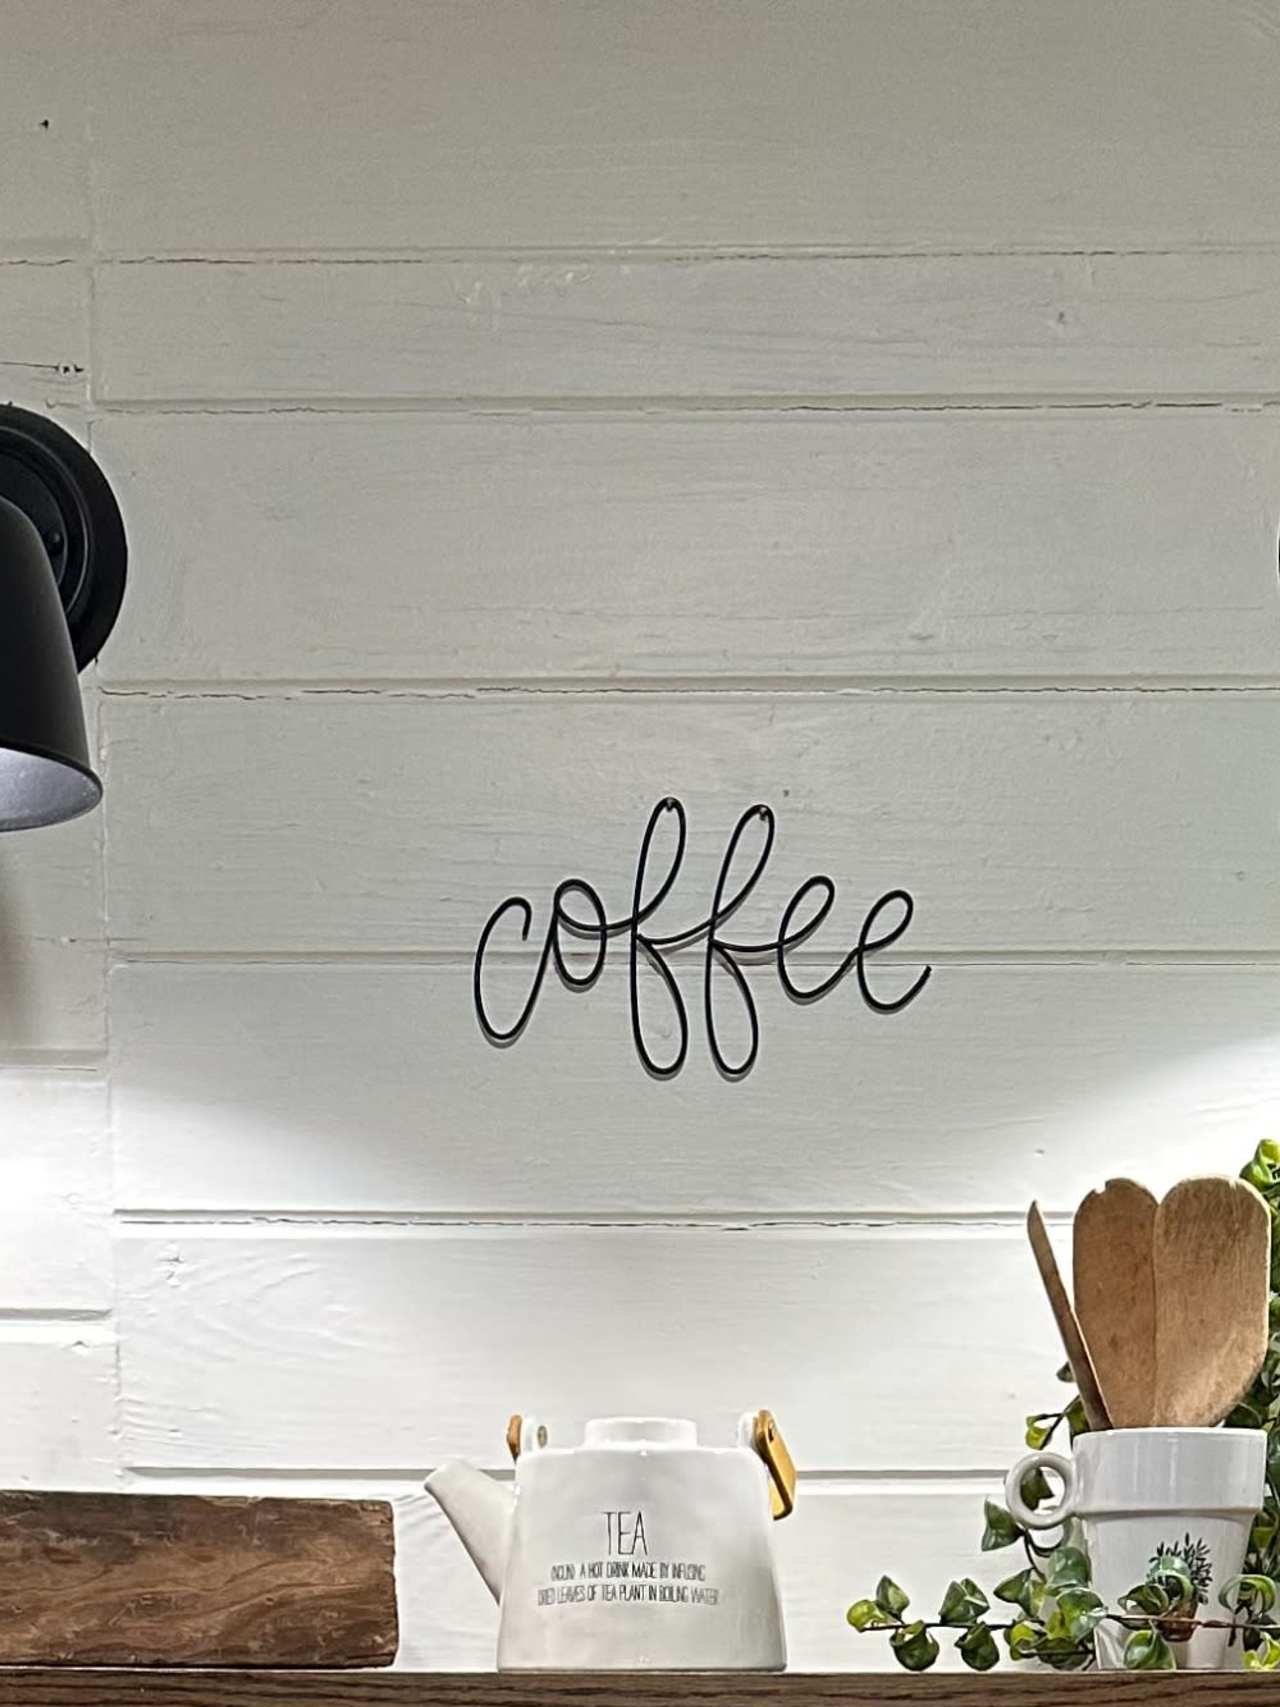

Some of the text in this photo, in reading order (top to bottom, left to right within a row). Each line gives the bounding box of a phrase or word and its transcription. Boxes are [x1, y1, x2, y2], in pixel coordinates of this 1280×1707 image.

[474, 796, 932, 1076] coffee
[602, 1511, 648, 1556] TEA
[580, 1563, 587, 1578] A
[588, 1561, 603, 1578] HOT
[606, 1561, 630, 1578] DRINK
[631, 1561, 657, 1578] MADE
[557, 1585, 586, 1604] LEAVES
[587, 1584, 597, 1601] OF
[601, 1584, 617, 1601] TEA
[619, 1584, 647, 1601] PLANT
[648, 1584, 658, 1601] IN
